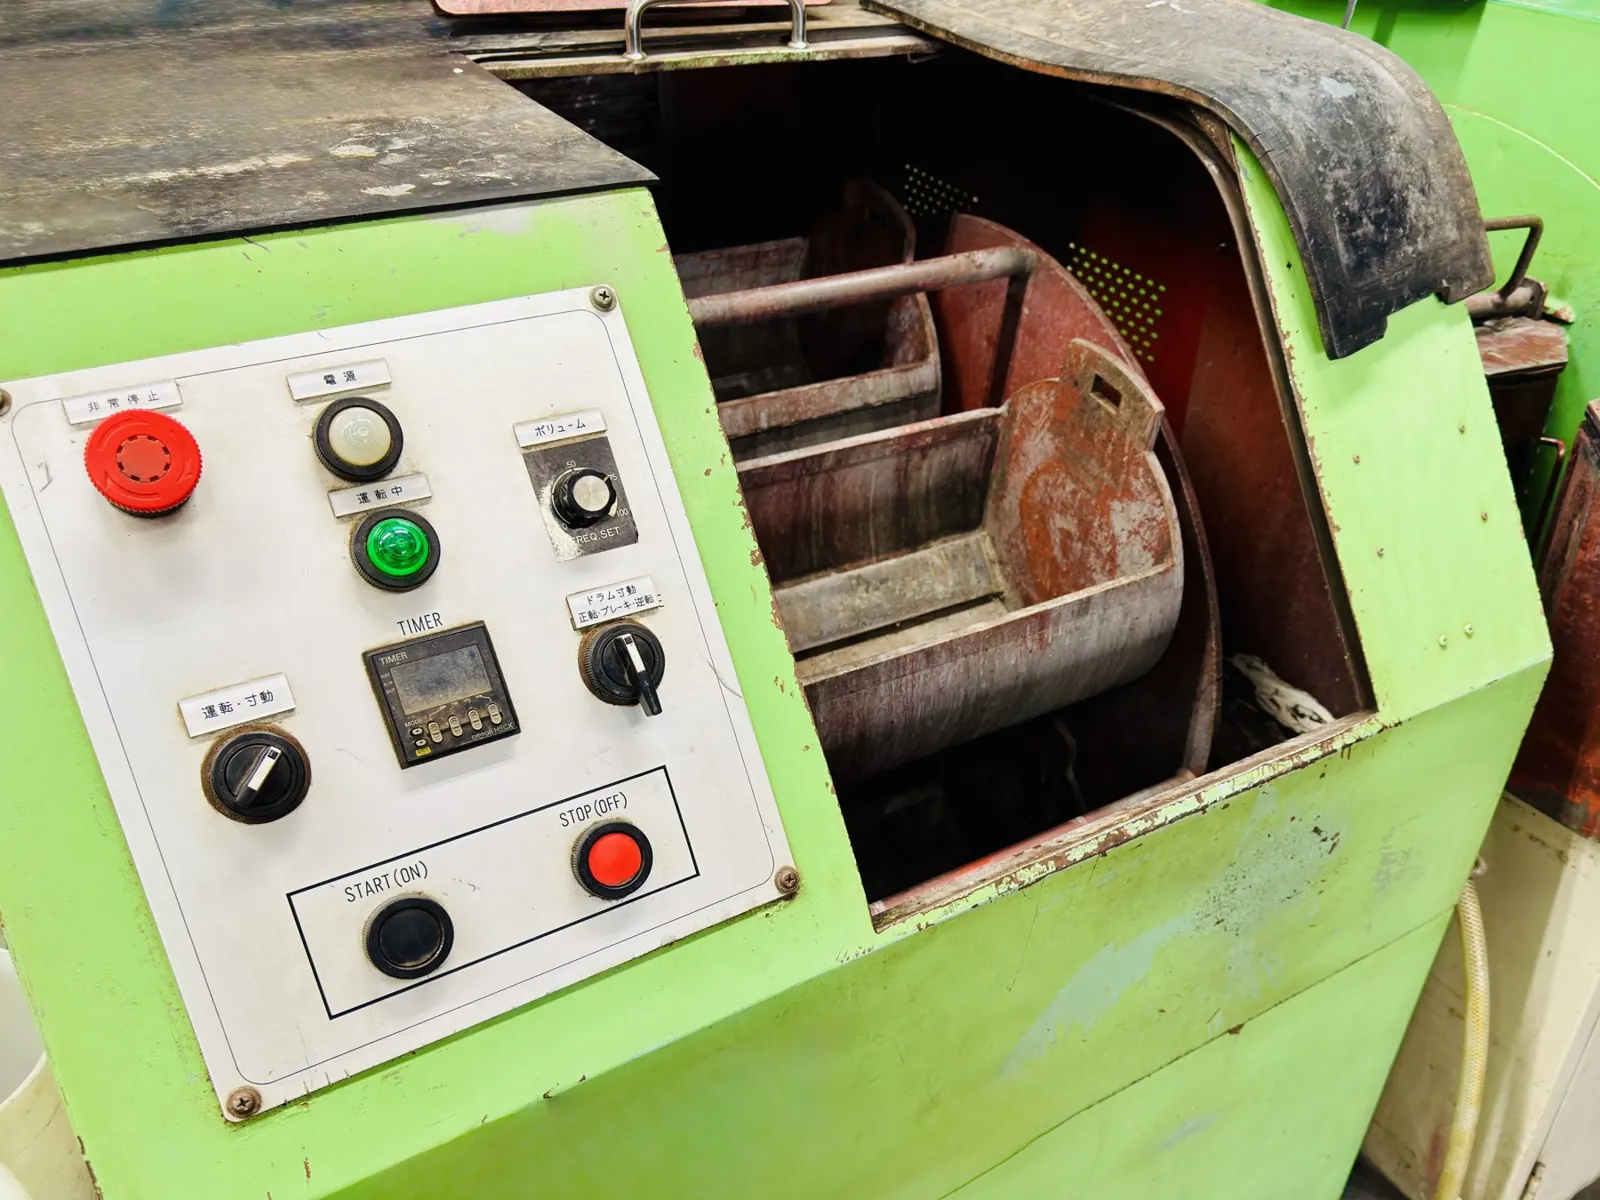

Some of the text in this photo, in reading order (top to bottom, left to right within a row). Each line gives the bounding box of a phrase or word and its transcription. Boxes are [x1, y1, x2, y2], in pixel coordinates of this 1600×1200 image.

[323, 370, 357, 386] 電源
[88, 390, 160, 412] 非常停止
[534, 418, 586, 437] ボリューム
[566, 460, 576, 469] 50
[356, 485, 403, 505] 運転中
[586, 584, 637, 606] ドラム寸動
[396, 612, 443, 636] TIMER
[379, 651, 408, 665] TIMER
[201, 689, 274, 720] 運転・寸動
